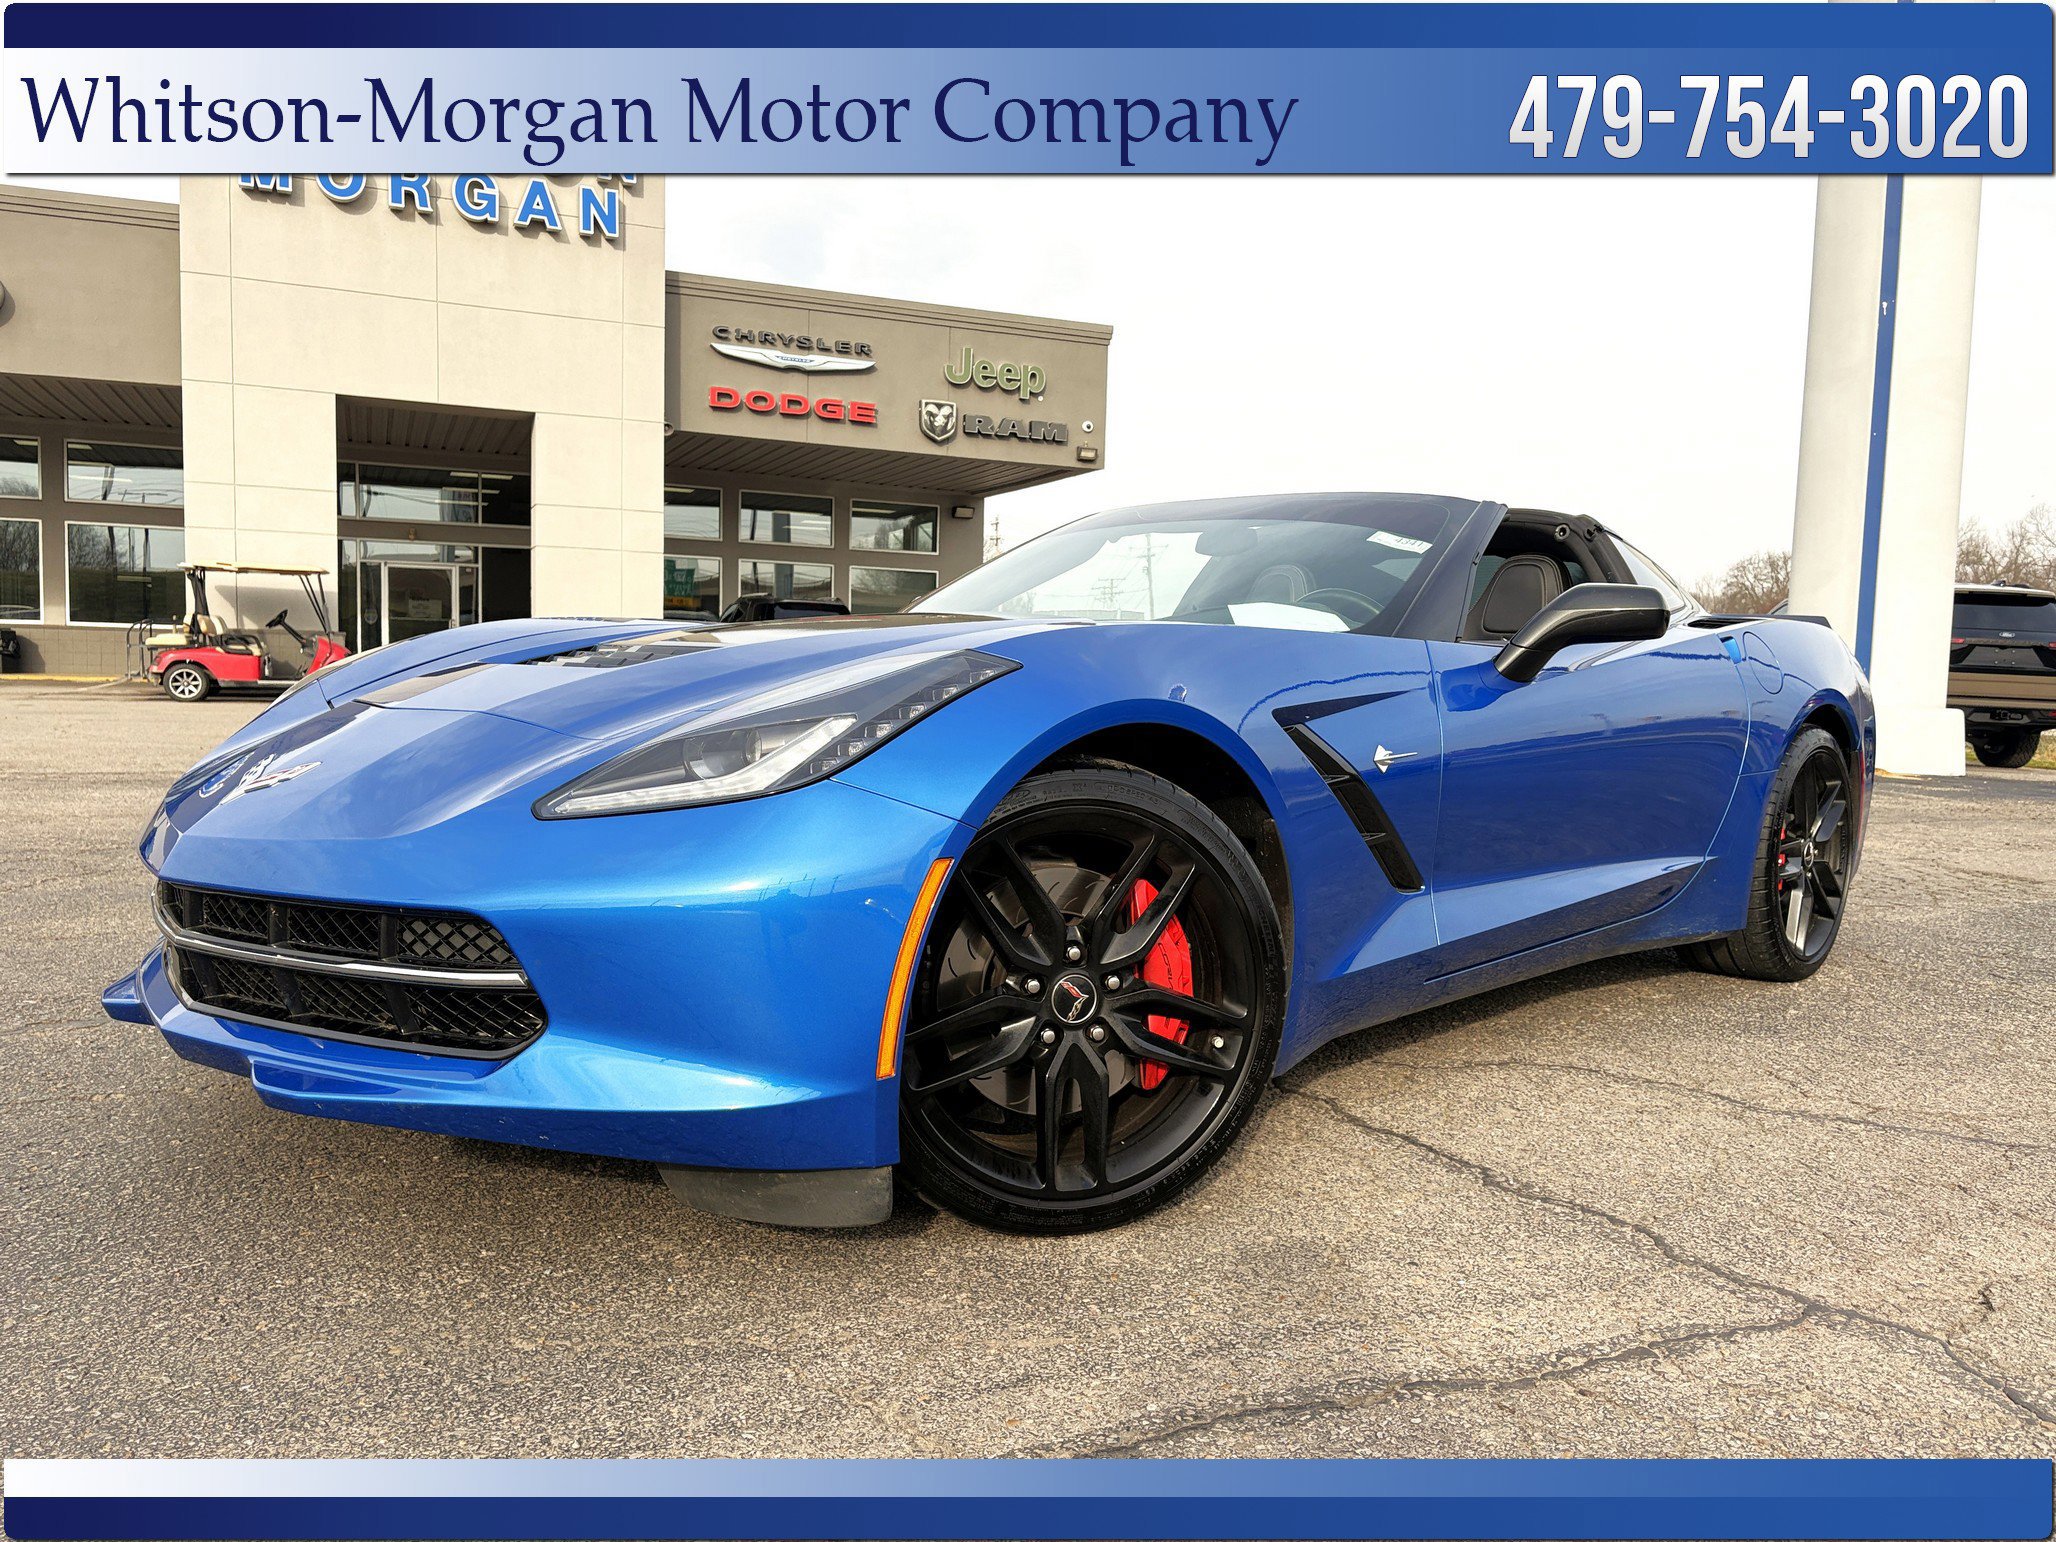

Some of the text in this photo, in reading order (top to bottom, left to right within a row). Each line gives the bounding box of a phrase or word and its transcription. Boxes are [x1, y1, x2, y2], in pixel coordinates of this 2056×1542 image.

[712, 325, 873, 356] CHRYSLER
[944, 347, 1046, 401] Jeep
[709, 386, 878, 424] DODGE
[963, 414, 1069, 443] RAM
